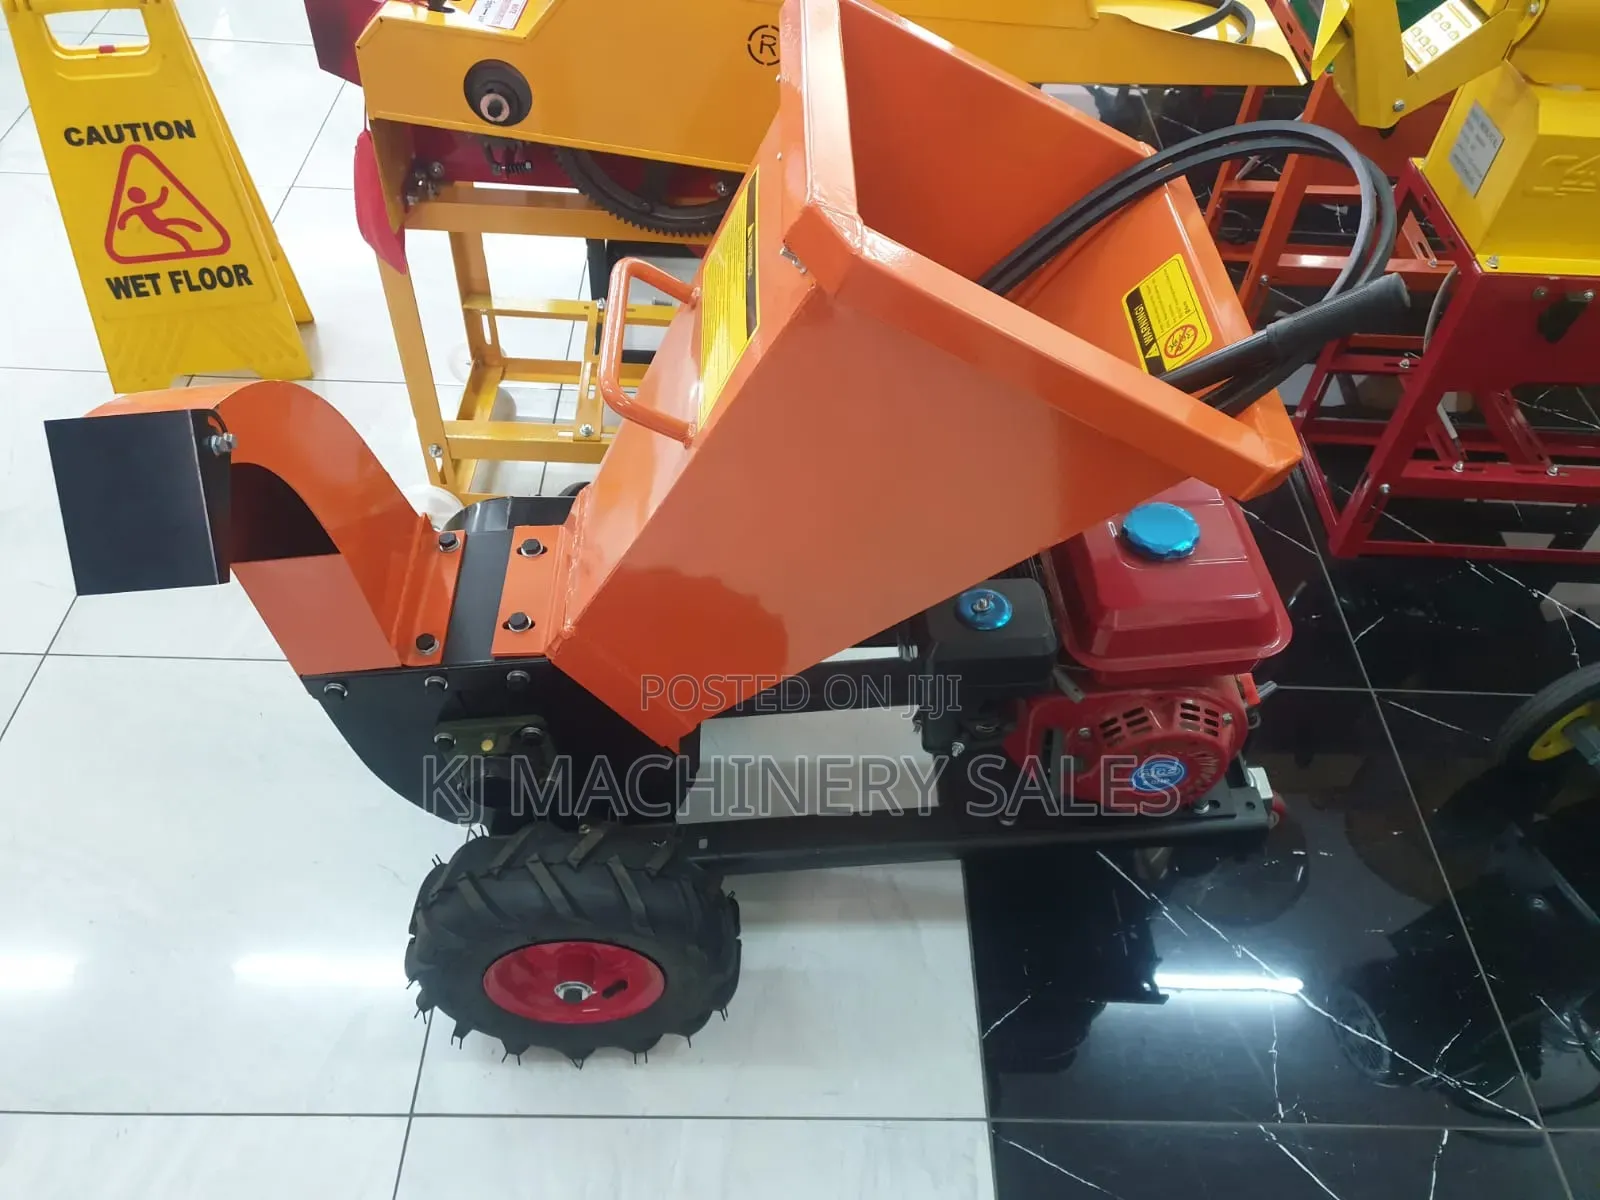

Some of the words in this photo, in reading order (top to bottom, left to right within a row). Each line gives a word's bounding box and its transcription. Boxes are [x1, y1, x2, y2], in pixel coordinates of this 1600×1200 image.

[63, 119, 197, 147] CAUTION
[105, 272, 162, 300] WET
[168, 263, 254, 294] FLOOR
